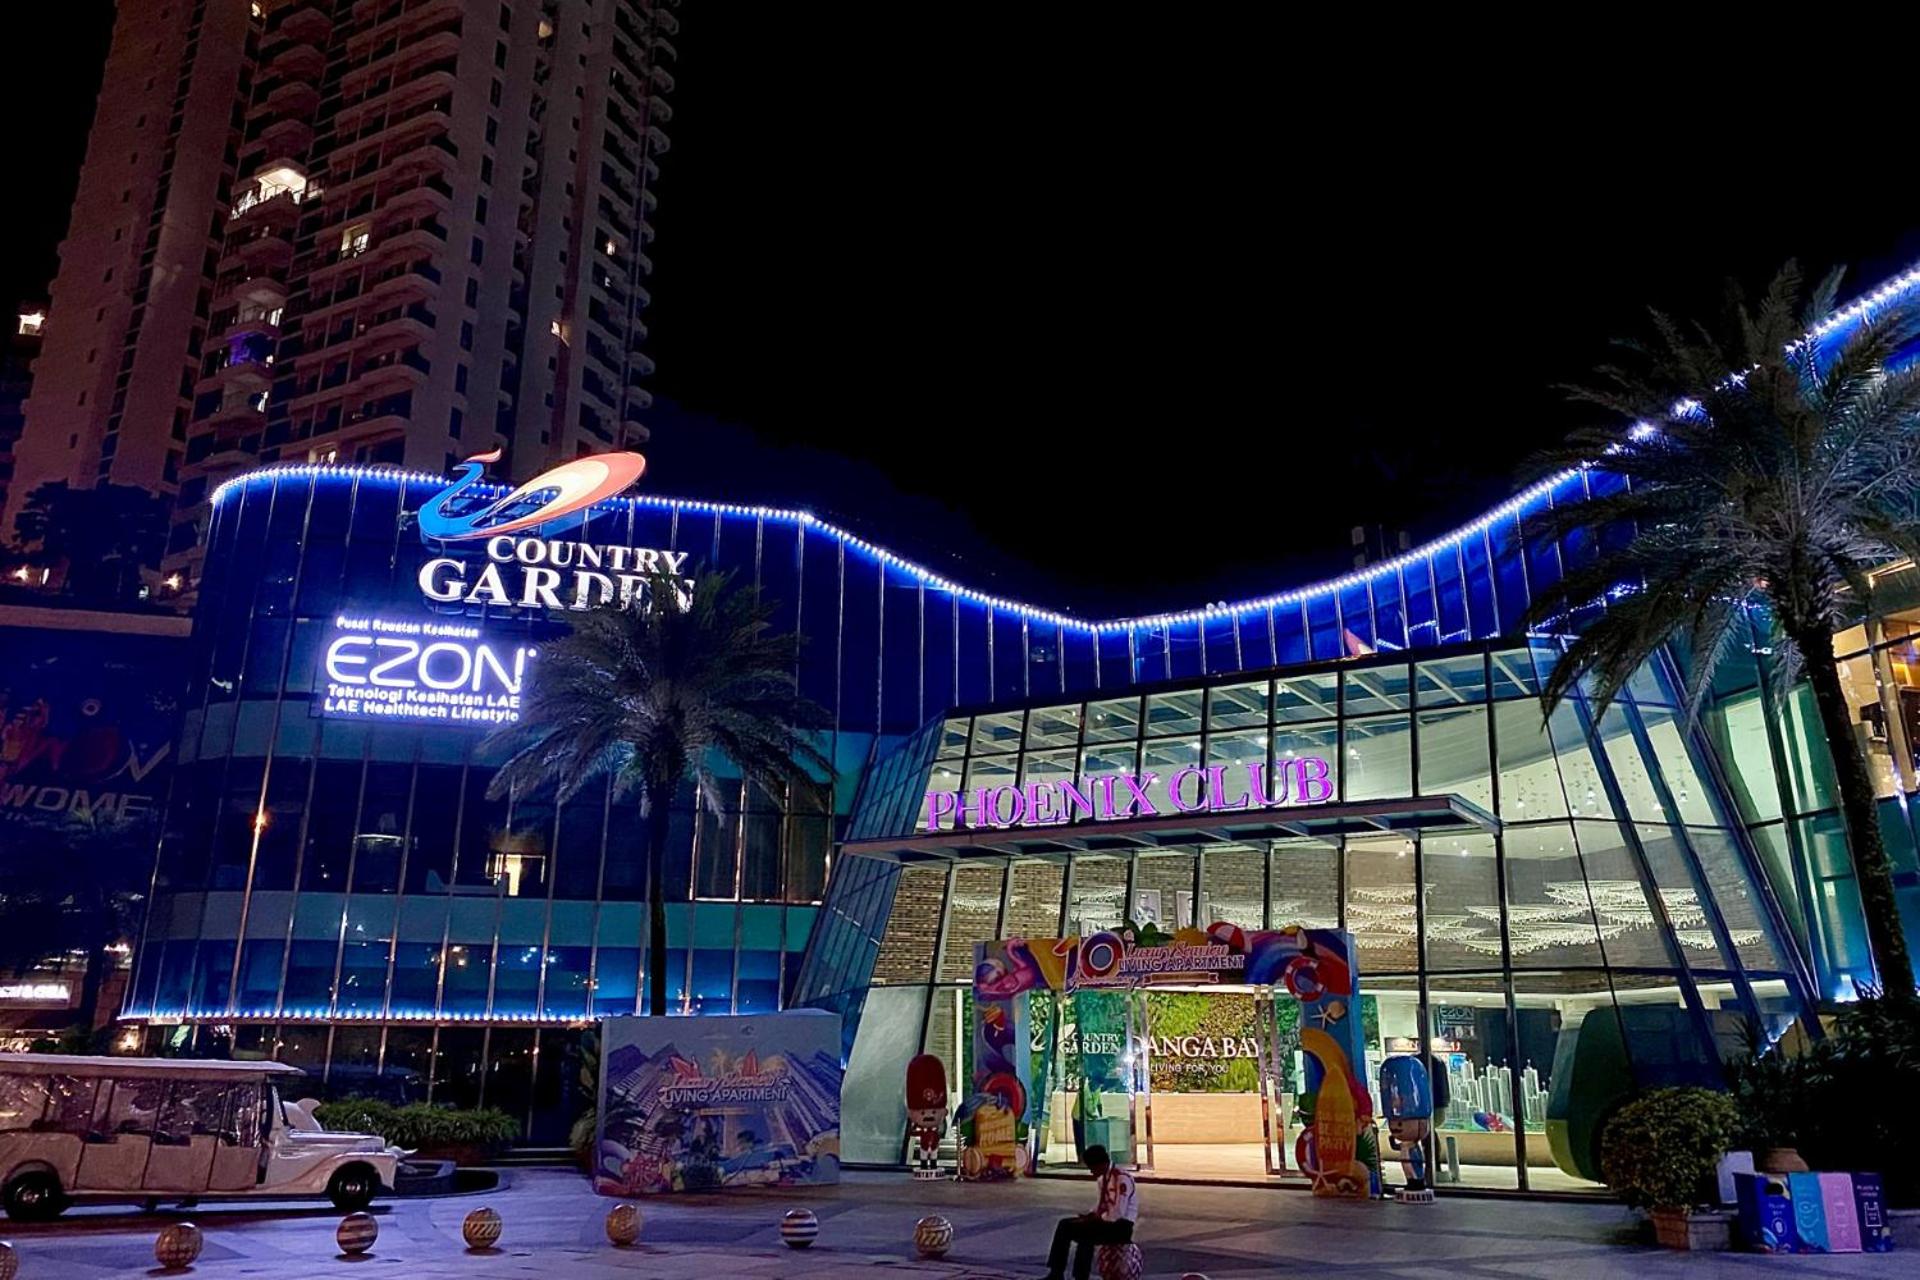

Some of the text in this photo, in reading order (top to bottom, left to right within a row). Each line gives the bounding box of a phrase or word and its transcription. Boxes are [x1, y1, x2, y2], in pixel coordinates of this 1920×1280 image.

[488, 536, 688, 575] COUNTRY
[336, 616, 369, 630] Pusat
[326, 635, 526, 694] EZON
[328, 683, 520, 709] Teknologi Kesihatan LAE
[324, 698, 520, 724] LAE Healthtech Lifestyle
[924, 757, 1333, 832] PHOENIX CLUB
[1119, 954, 1244, 972] LIVING APARTMENT
[1221, 1036, 1259, 1058] BAY
[711, 1086, 788, 1102] APARTMENT
